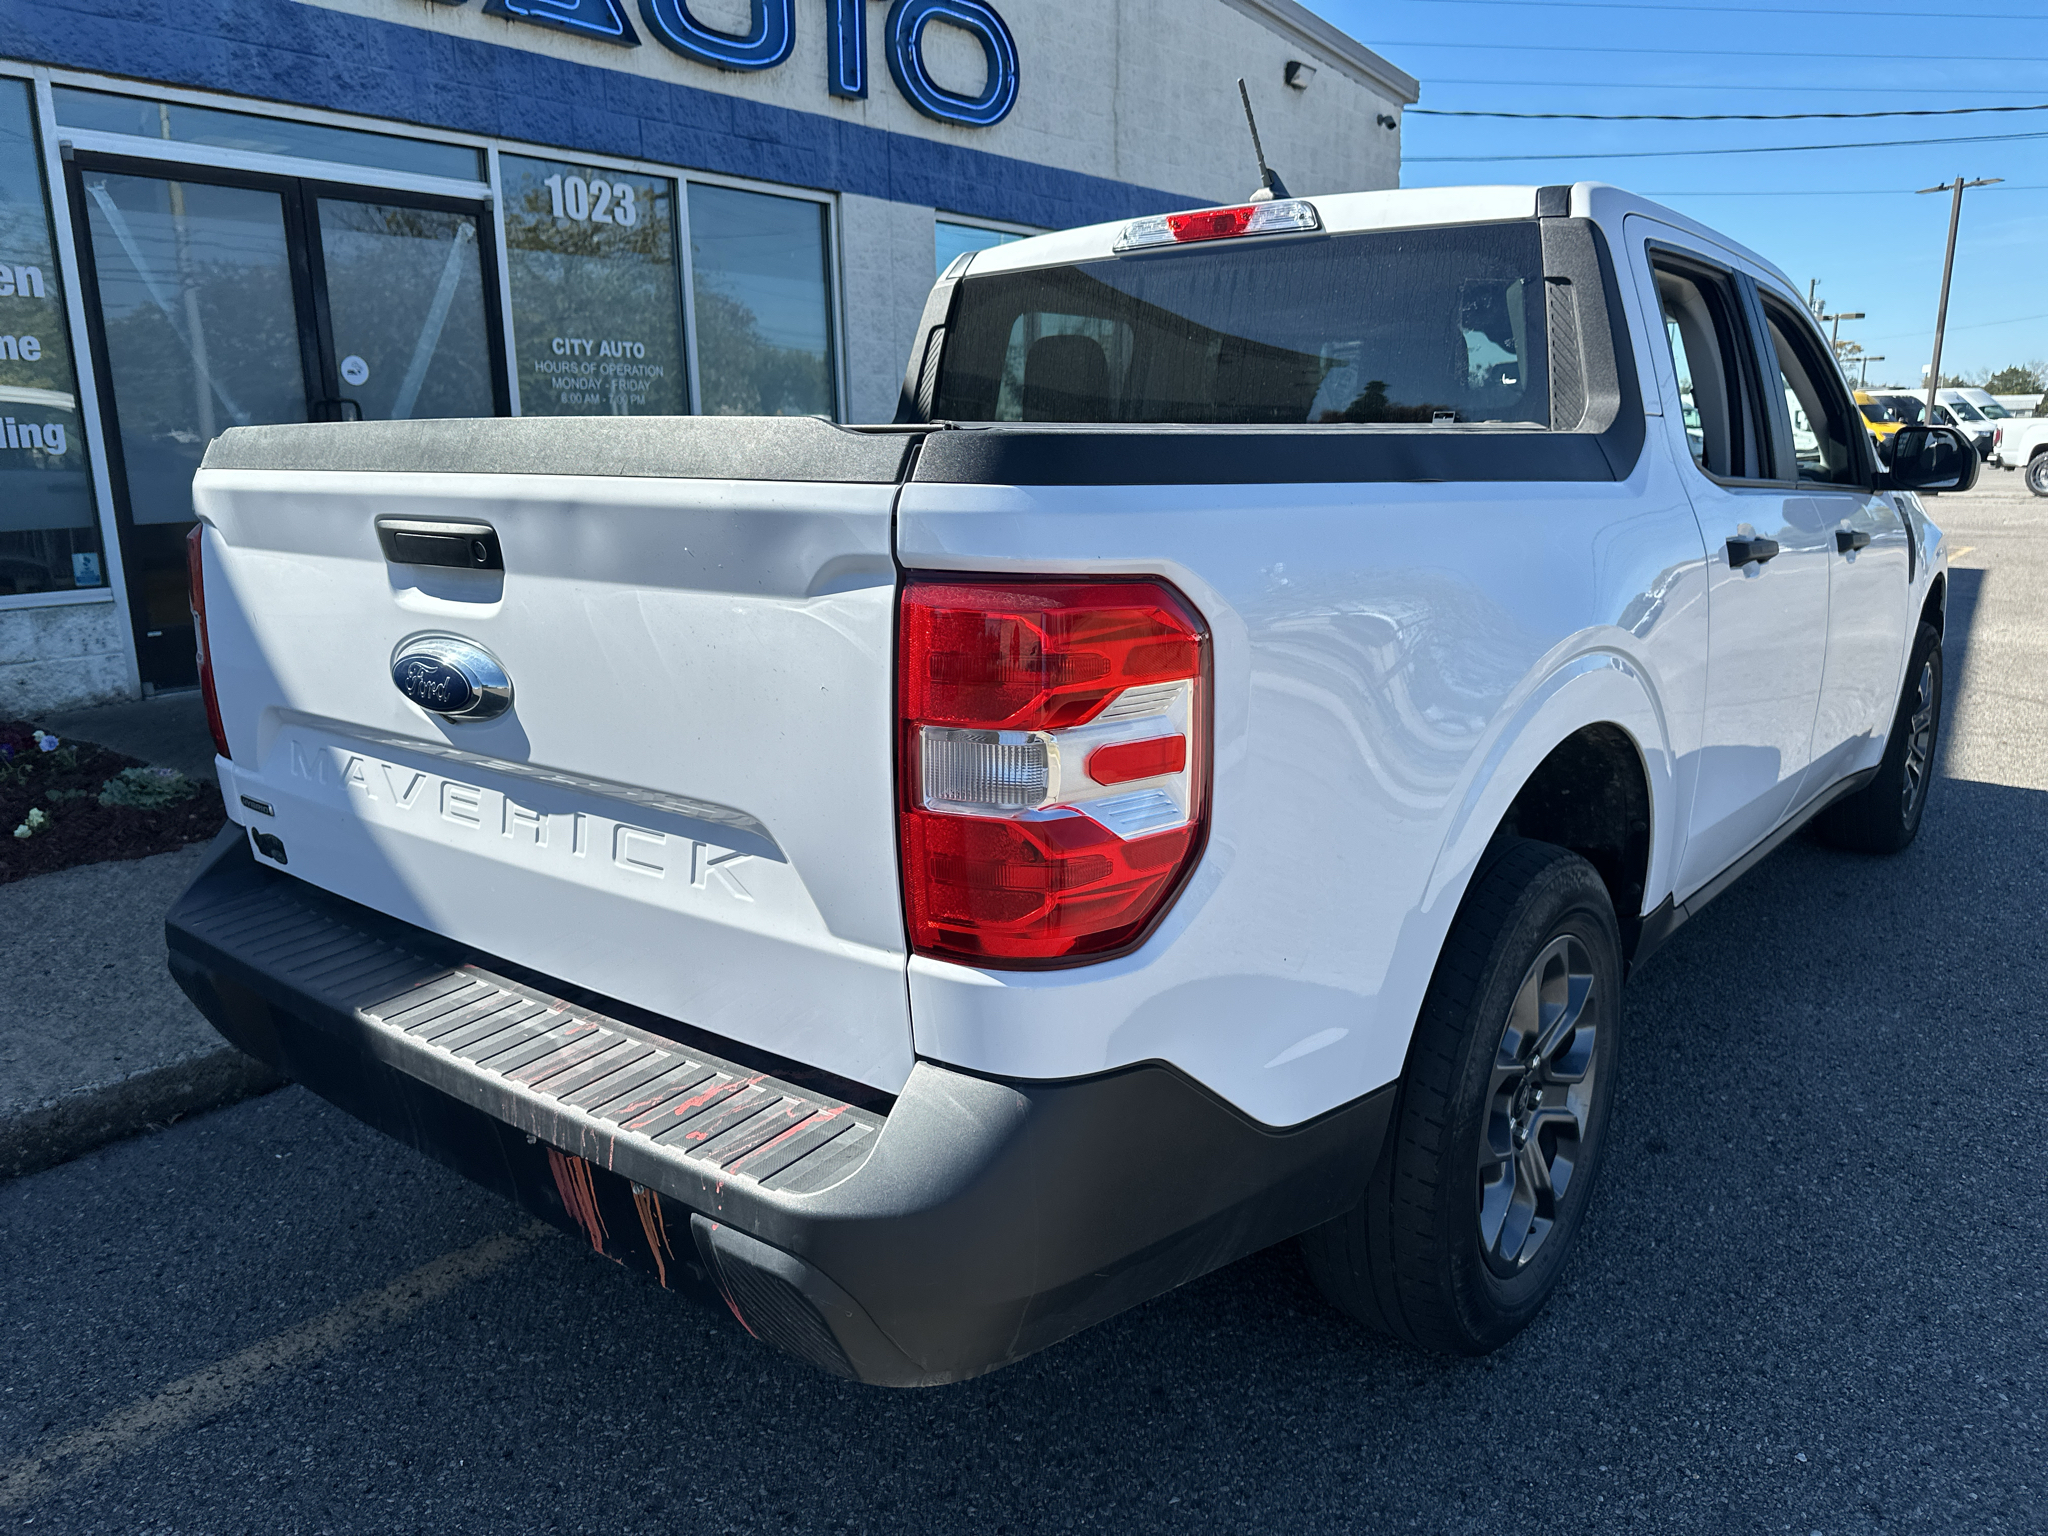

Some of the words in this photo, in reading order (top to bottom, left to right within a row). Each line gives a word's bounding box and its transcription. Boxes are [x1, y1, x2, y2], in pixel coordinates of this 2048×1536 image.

[480, 0, 1021, 128] UTO
[544, 174, 637, 227] 1023
[552, 337, 594, 356] CITY
[599, 340, 645, 359] AUTO
[534, 360, 579, 374] HOURS
[580, 362, 597, 375] OF
[600, 363, 664, 378] OPERATION
[551, 376, 602, 391] MONDAY
[612, 379, 651, 392] FRIDAY
[584, 393, 600, 405] AM
[630, 394, 646, 405] PM
[404, 661, 451, 703] Ford
[290, 739, 755, 902] MAVERICK
